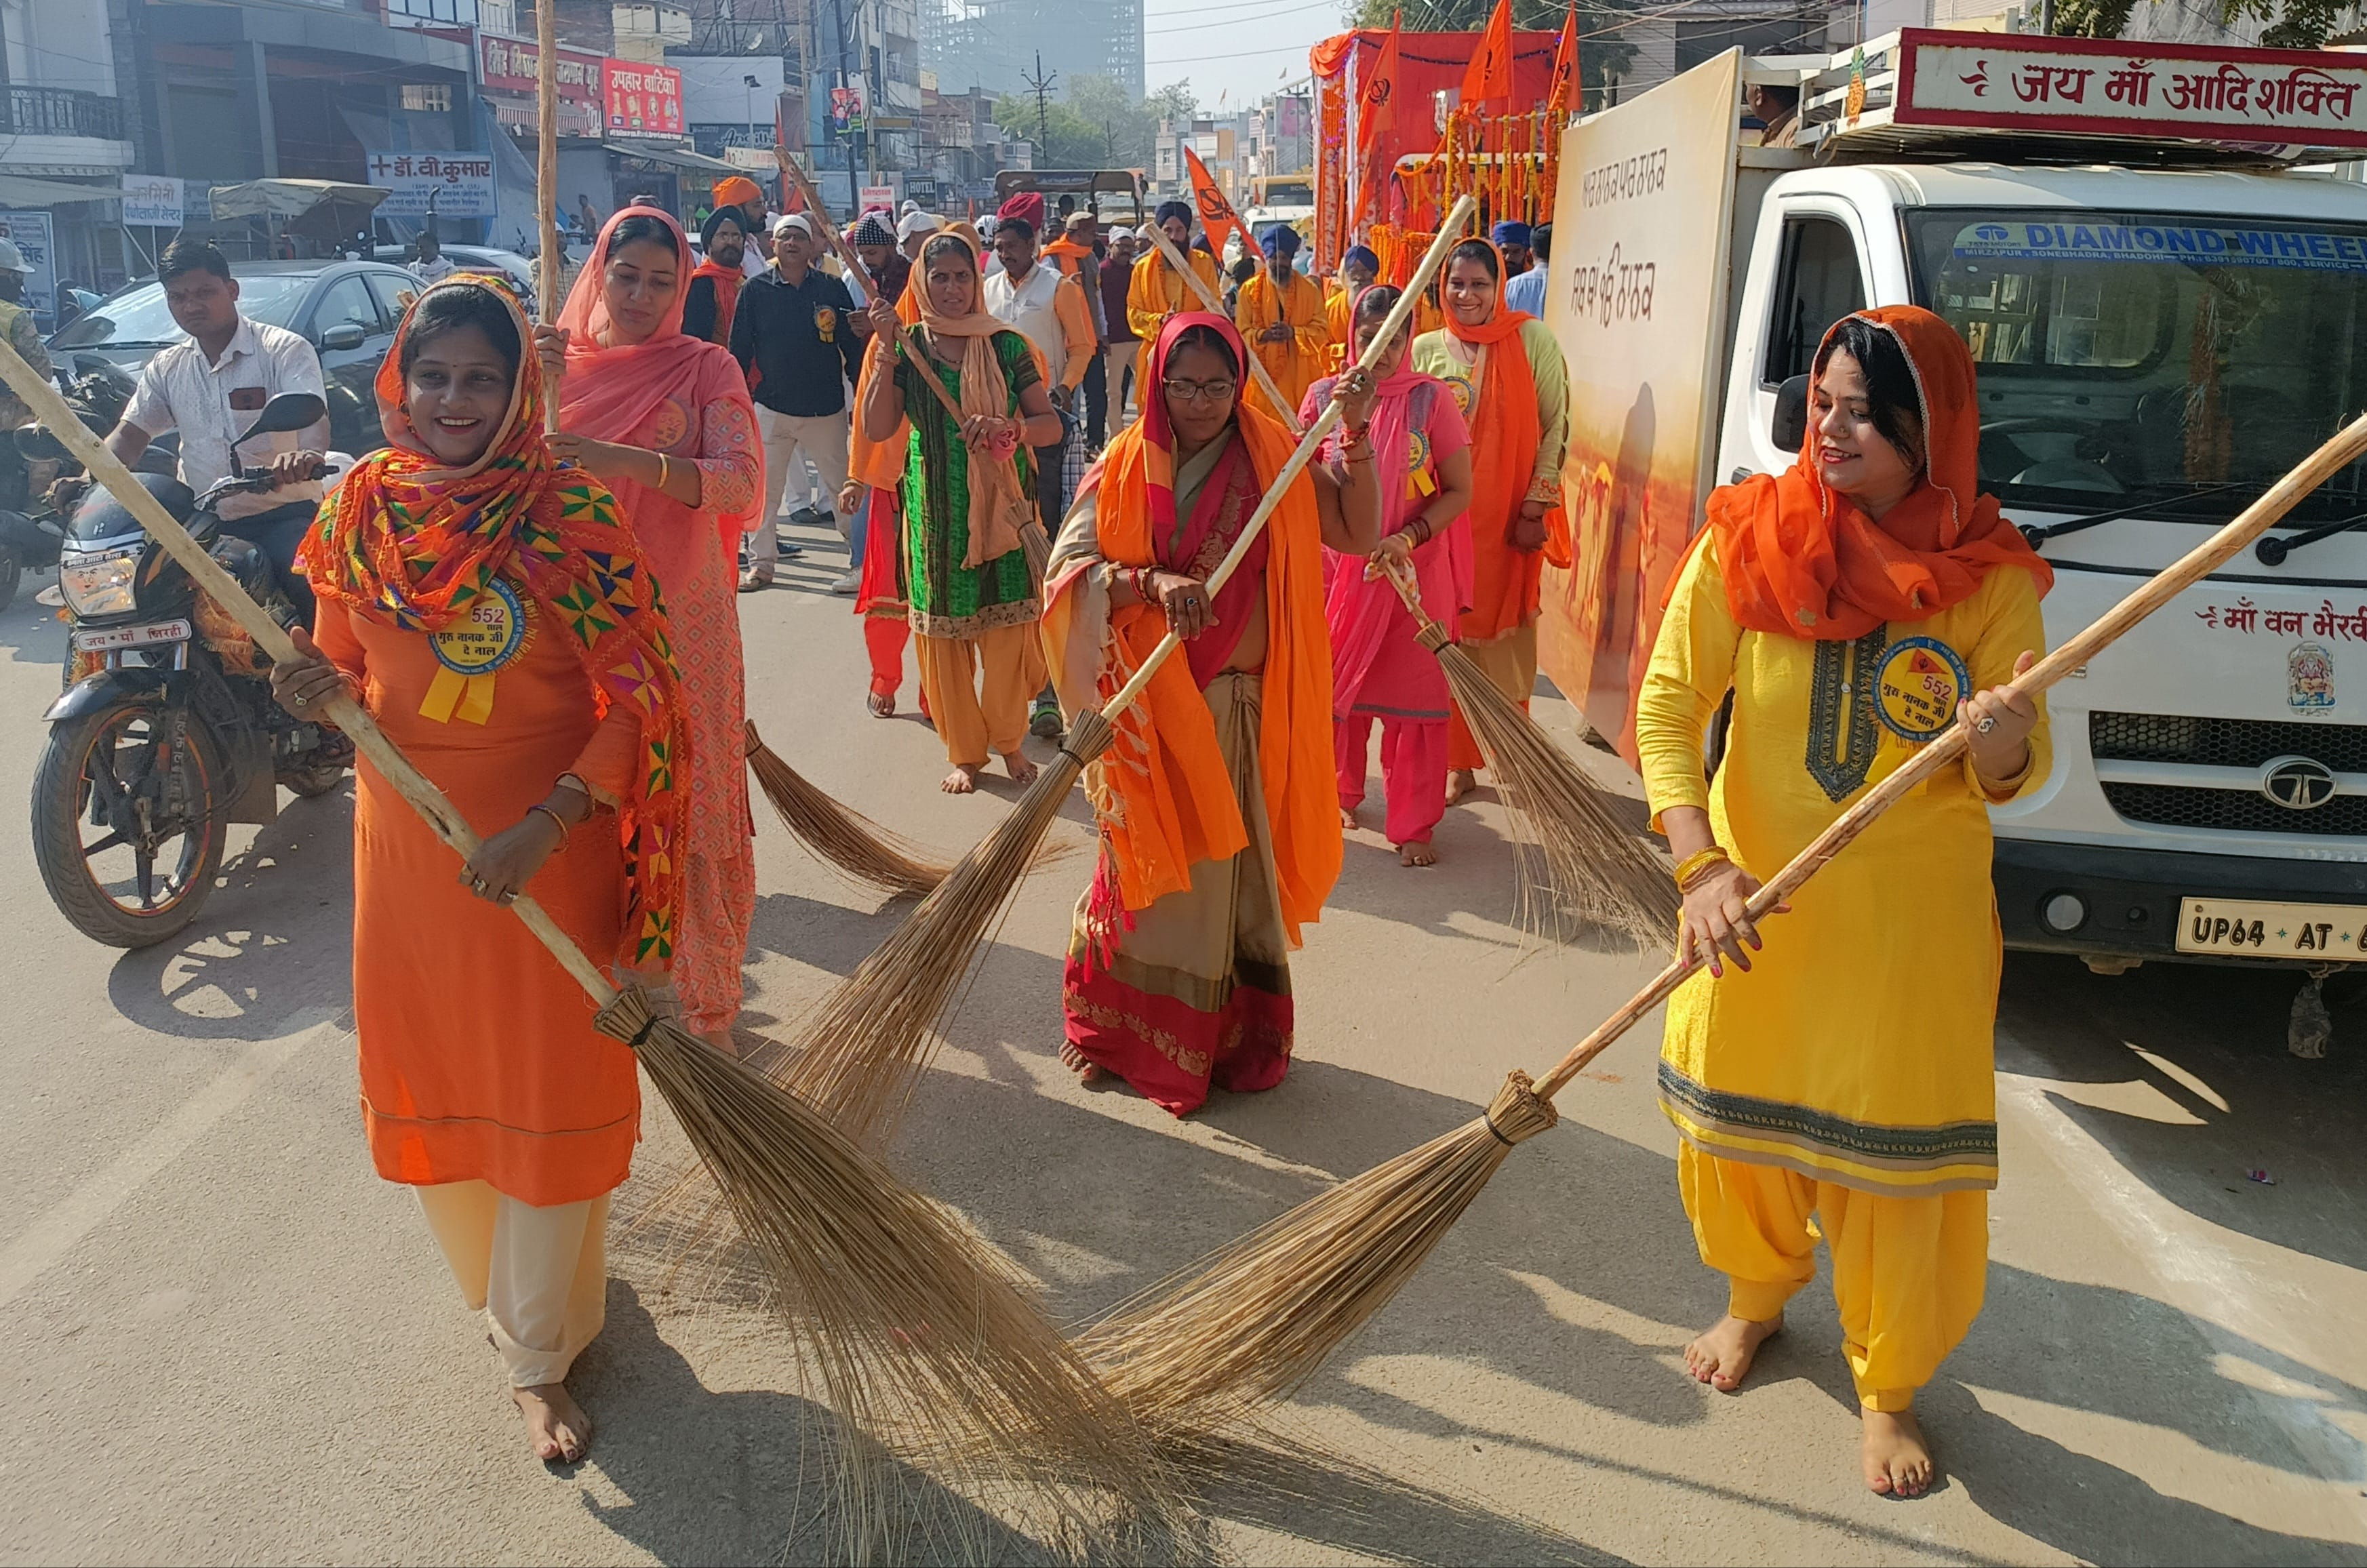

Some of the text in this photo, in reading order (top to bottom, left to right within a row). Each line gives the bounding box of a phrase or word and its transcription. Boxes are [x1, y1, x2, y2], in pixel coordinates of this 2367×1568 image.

[611, 68, 675, 95] उपहार वाटिका
[2011, 64, 2095, 104] जय
[2105, 57, 2156, 107] माँ
[910, 182, 935, 194] HOTEL
[2025, 224, 2225, 254] DIAMOND
[472, 608, 504, 624] 552
[2263, 610, 2309, 639] वन
[85, 637, 106, 647] जय
[457, 632, 485, 643] नानक
[490, 632, 503, 643] जी
[463, 645, 496, 656] दे नाल
[1922, 675, 1953, 702] 552
[1902, 691, 1930, 711] नानक
[1932, 705, 1945, 719] जी
[1904, 704, 1912, 718] दे
[1914, 712, 1935, 729] नाल
[2192, 917, 2265, 948] UP64
[2294, 922, 2333, 950] AT
